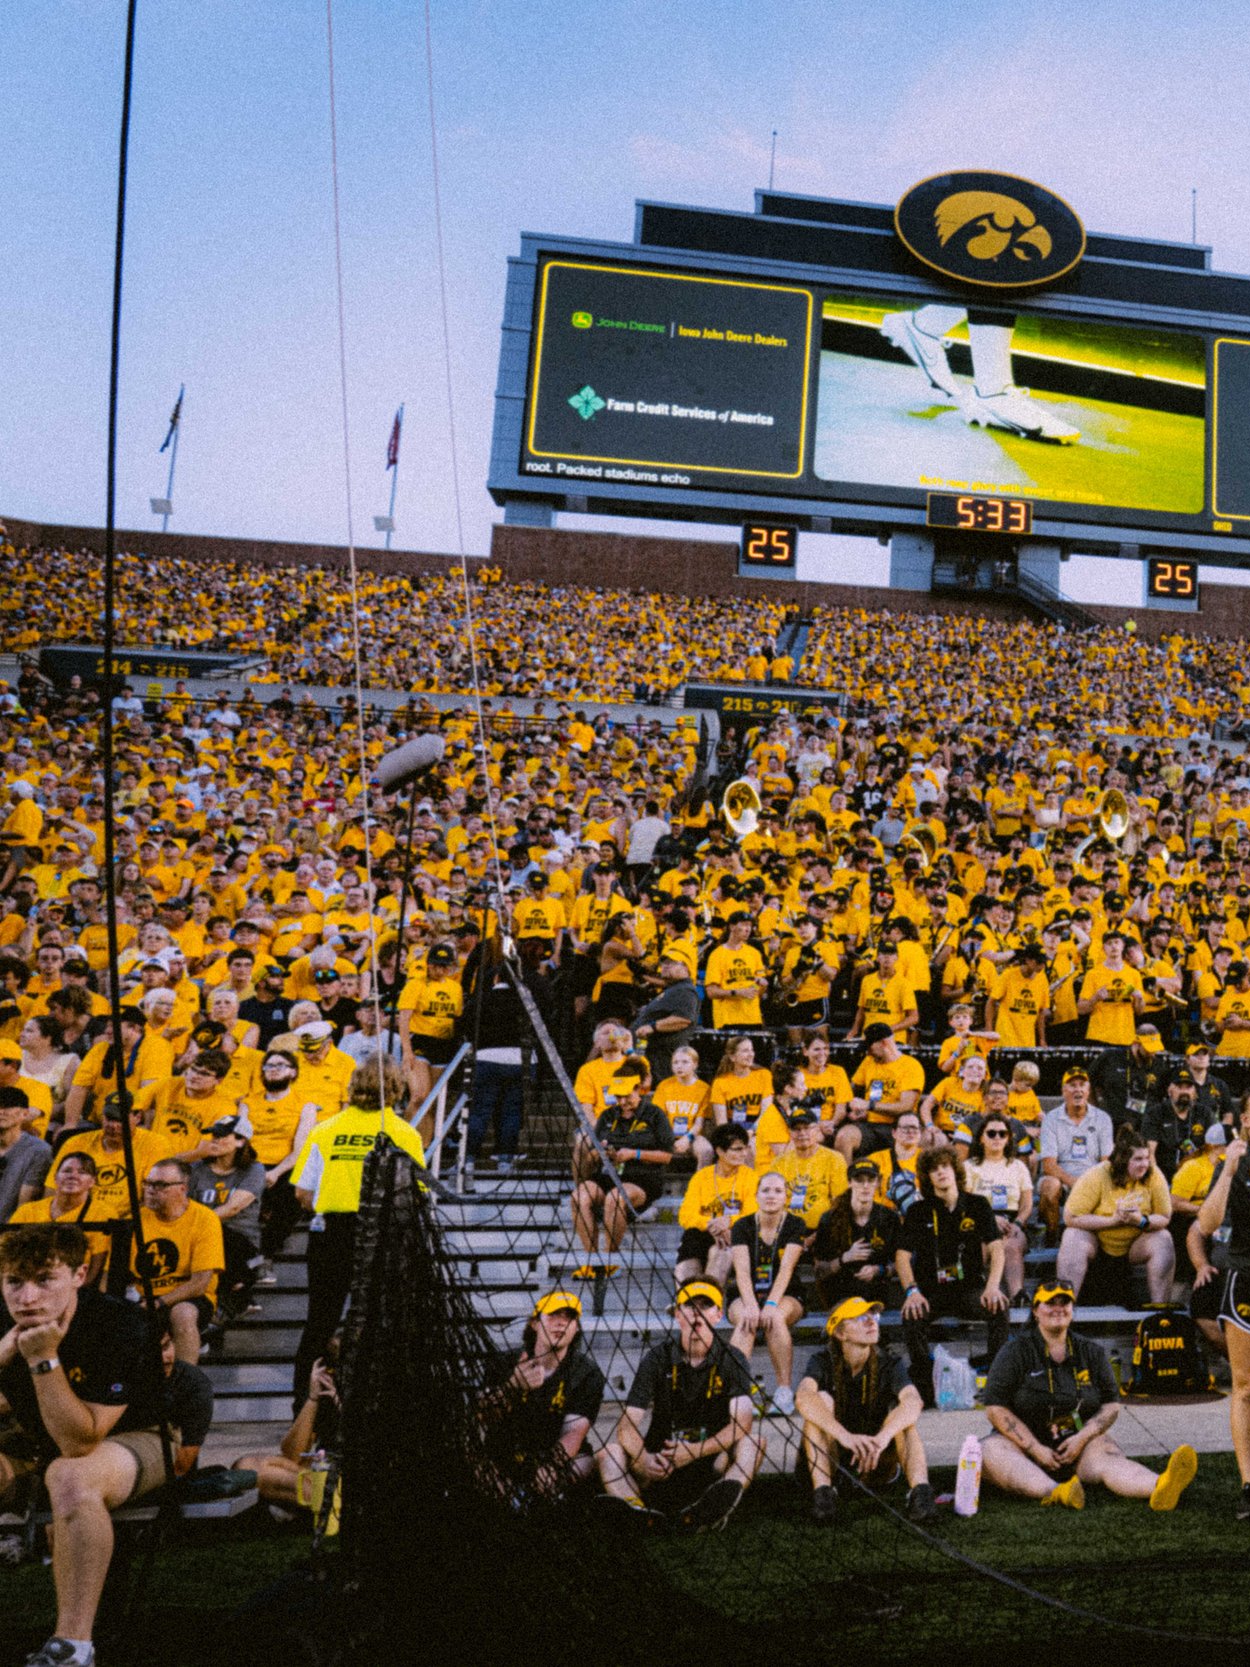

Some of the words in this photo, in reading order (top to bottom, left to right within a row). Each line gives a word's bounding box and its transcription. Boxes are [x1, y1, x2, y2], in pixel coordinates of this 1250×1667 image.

[678, 325, 701, 338] Iowa
[702, 327, 724, 340] John
[726, 330, 752, 343] Deere
[754, 333, 788, 347] Dealers
[607, 398, 634, 411] Farm
[636, 401, 669, 416] Credit
[671, 404, 716, 420] Services
[718, 411, 729, 424] of
[730, 410, 774, 426] America
[526, 462, 553, 473] root.
[556, 463, 602, 477] Packed
[604, 468, 658, 482] stadiums
[660, 473, 691, 485] echo
[957, 497, 1026, 531] 5:33
[748, 528, 790, 560] 25
[1154, 563, 1193, 593] 25
[96, 659, 132, 675] 214
[722, 697, 753, 711] 215
[429, 1001, 456, 1013] IOWA
[866, 998, 888, 1009] IOWA
[1014, 998, 1036, 1010] IOWA
[726, 1094, 763, 1111] IOWA
[333, 1134, 376, 1146] BES
[1149, 1337, 1184, 1350] IOWA
